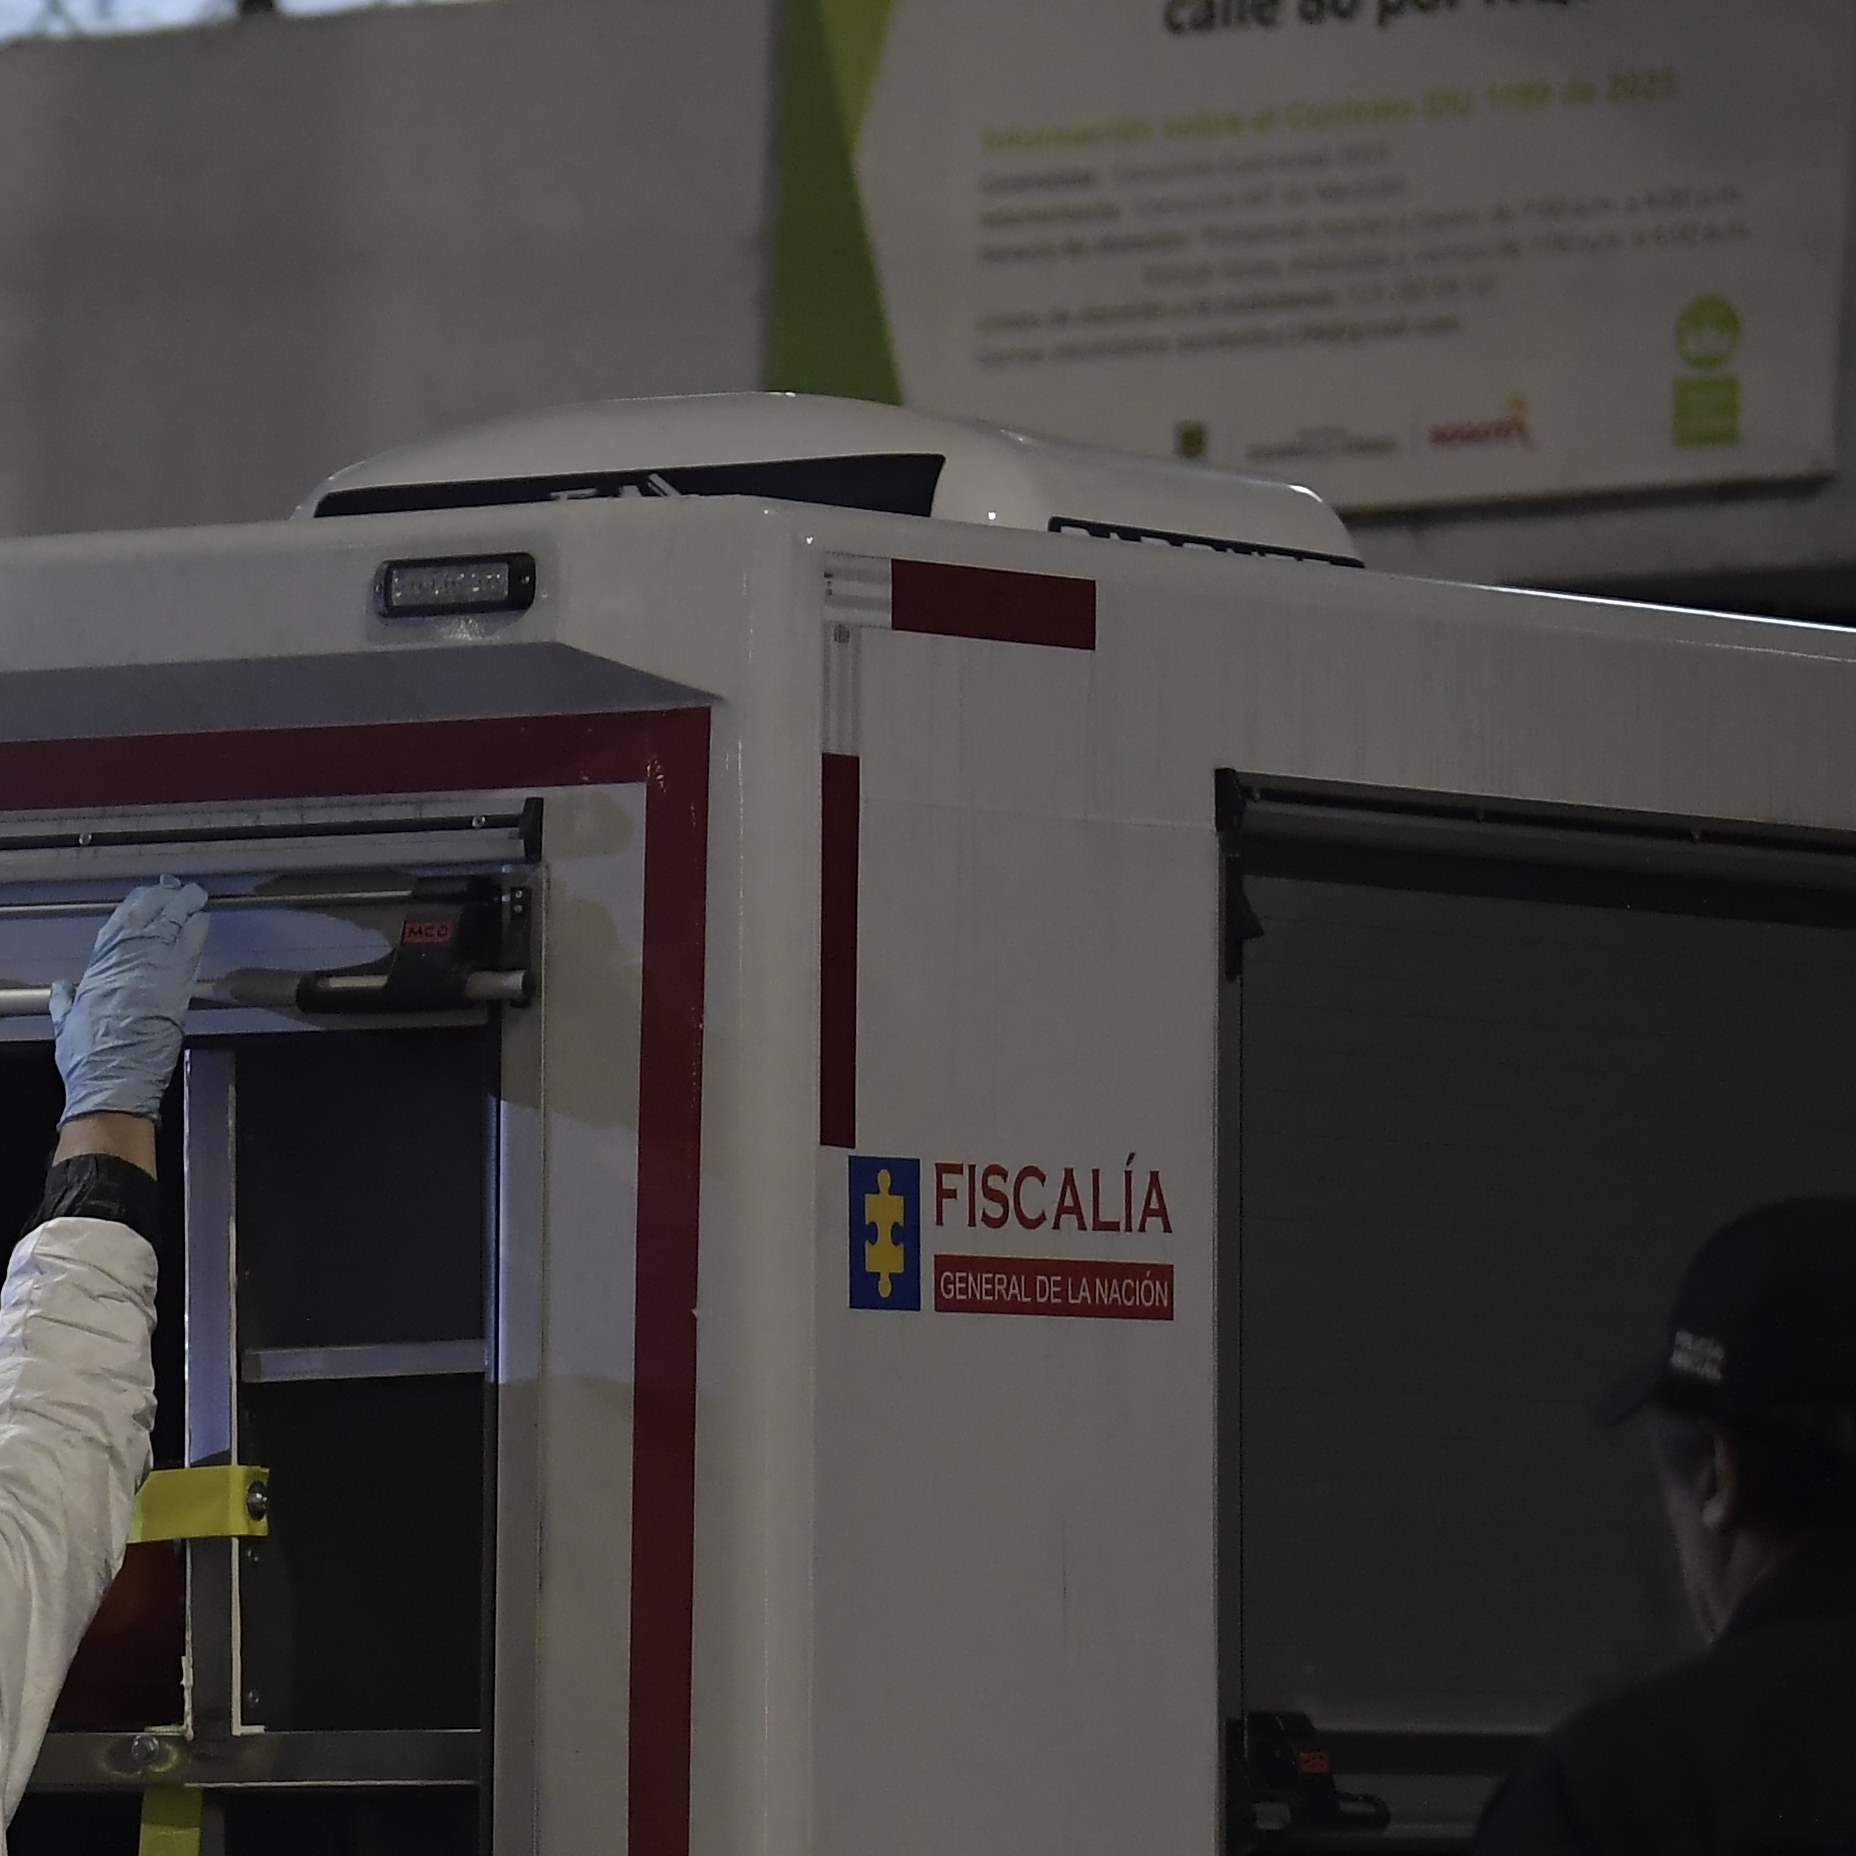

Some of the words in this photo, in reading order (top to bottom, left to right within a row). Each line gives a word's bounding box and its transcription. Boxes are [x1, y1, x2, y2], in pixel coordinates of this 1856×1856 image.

[934, 1152, 1174, 1234] FISCALÍA
[939, 1271, 1032, 1302] GENERAL
[1036, 1275, 1062, 1303] DE
[1067, 1278, 1092, 1305] LA
[1095, 1271, 1169, 1307] NACIÓN
